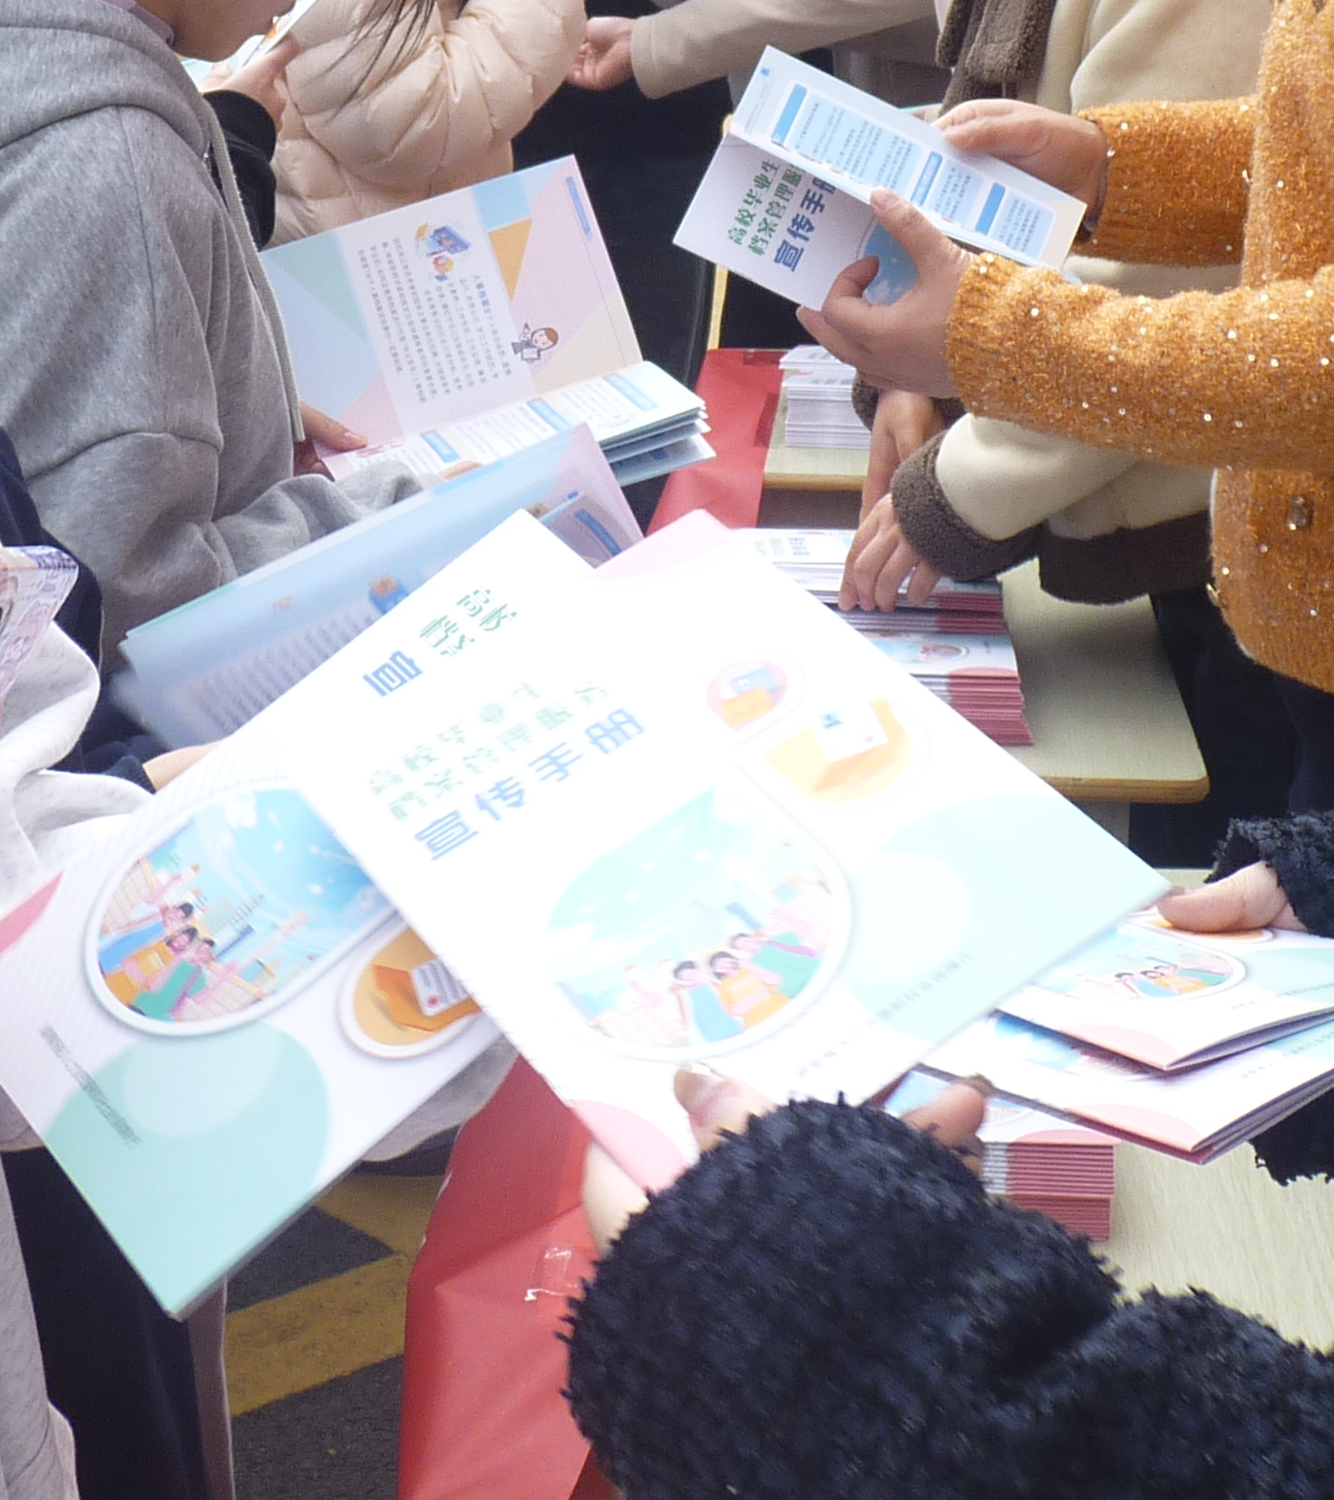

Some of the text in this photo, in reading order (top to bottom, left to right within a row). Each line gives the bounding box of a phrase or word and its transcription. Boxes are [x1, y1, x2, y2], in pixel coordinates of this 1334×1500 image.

[728, 160, 780, 245] 高校毕业生
[748, 164, 806, 256] 档案管理服
[414, 707, 646, 860] 宣传手册
